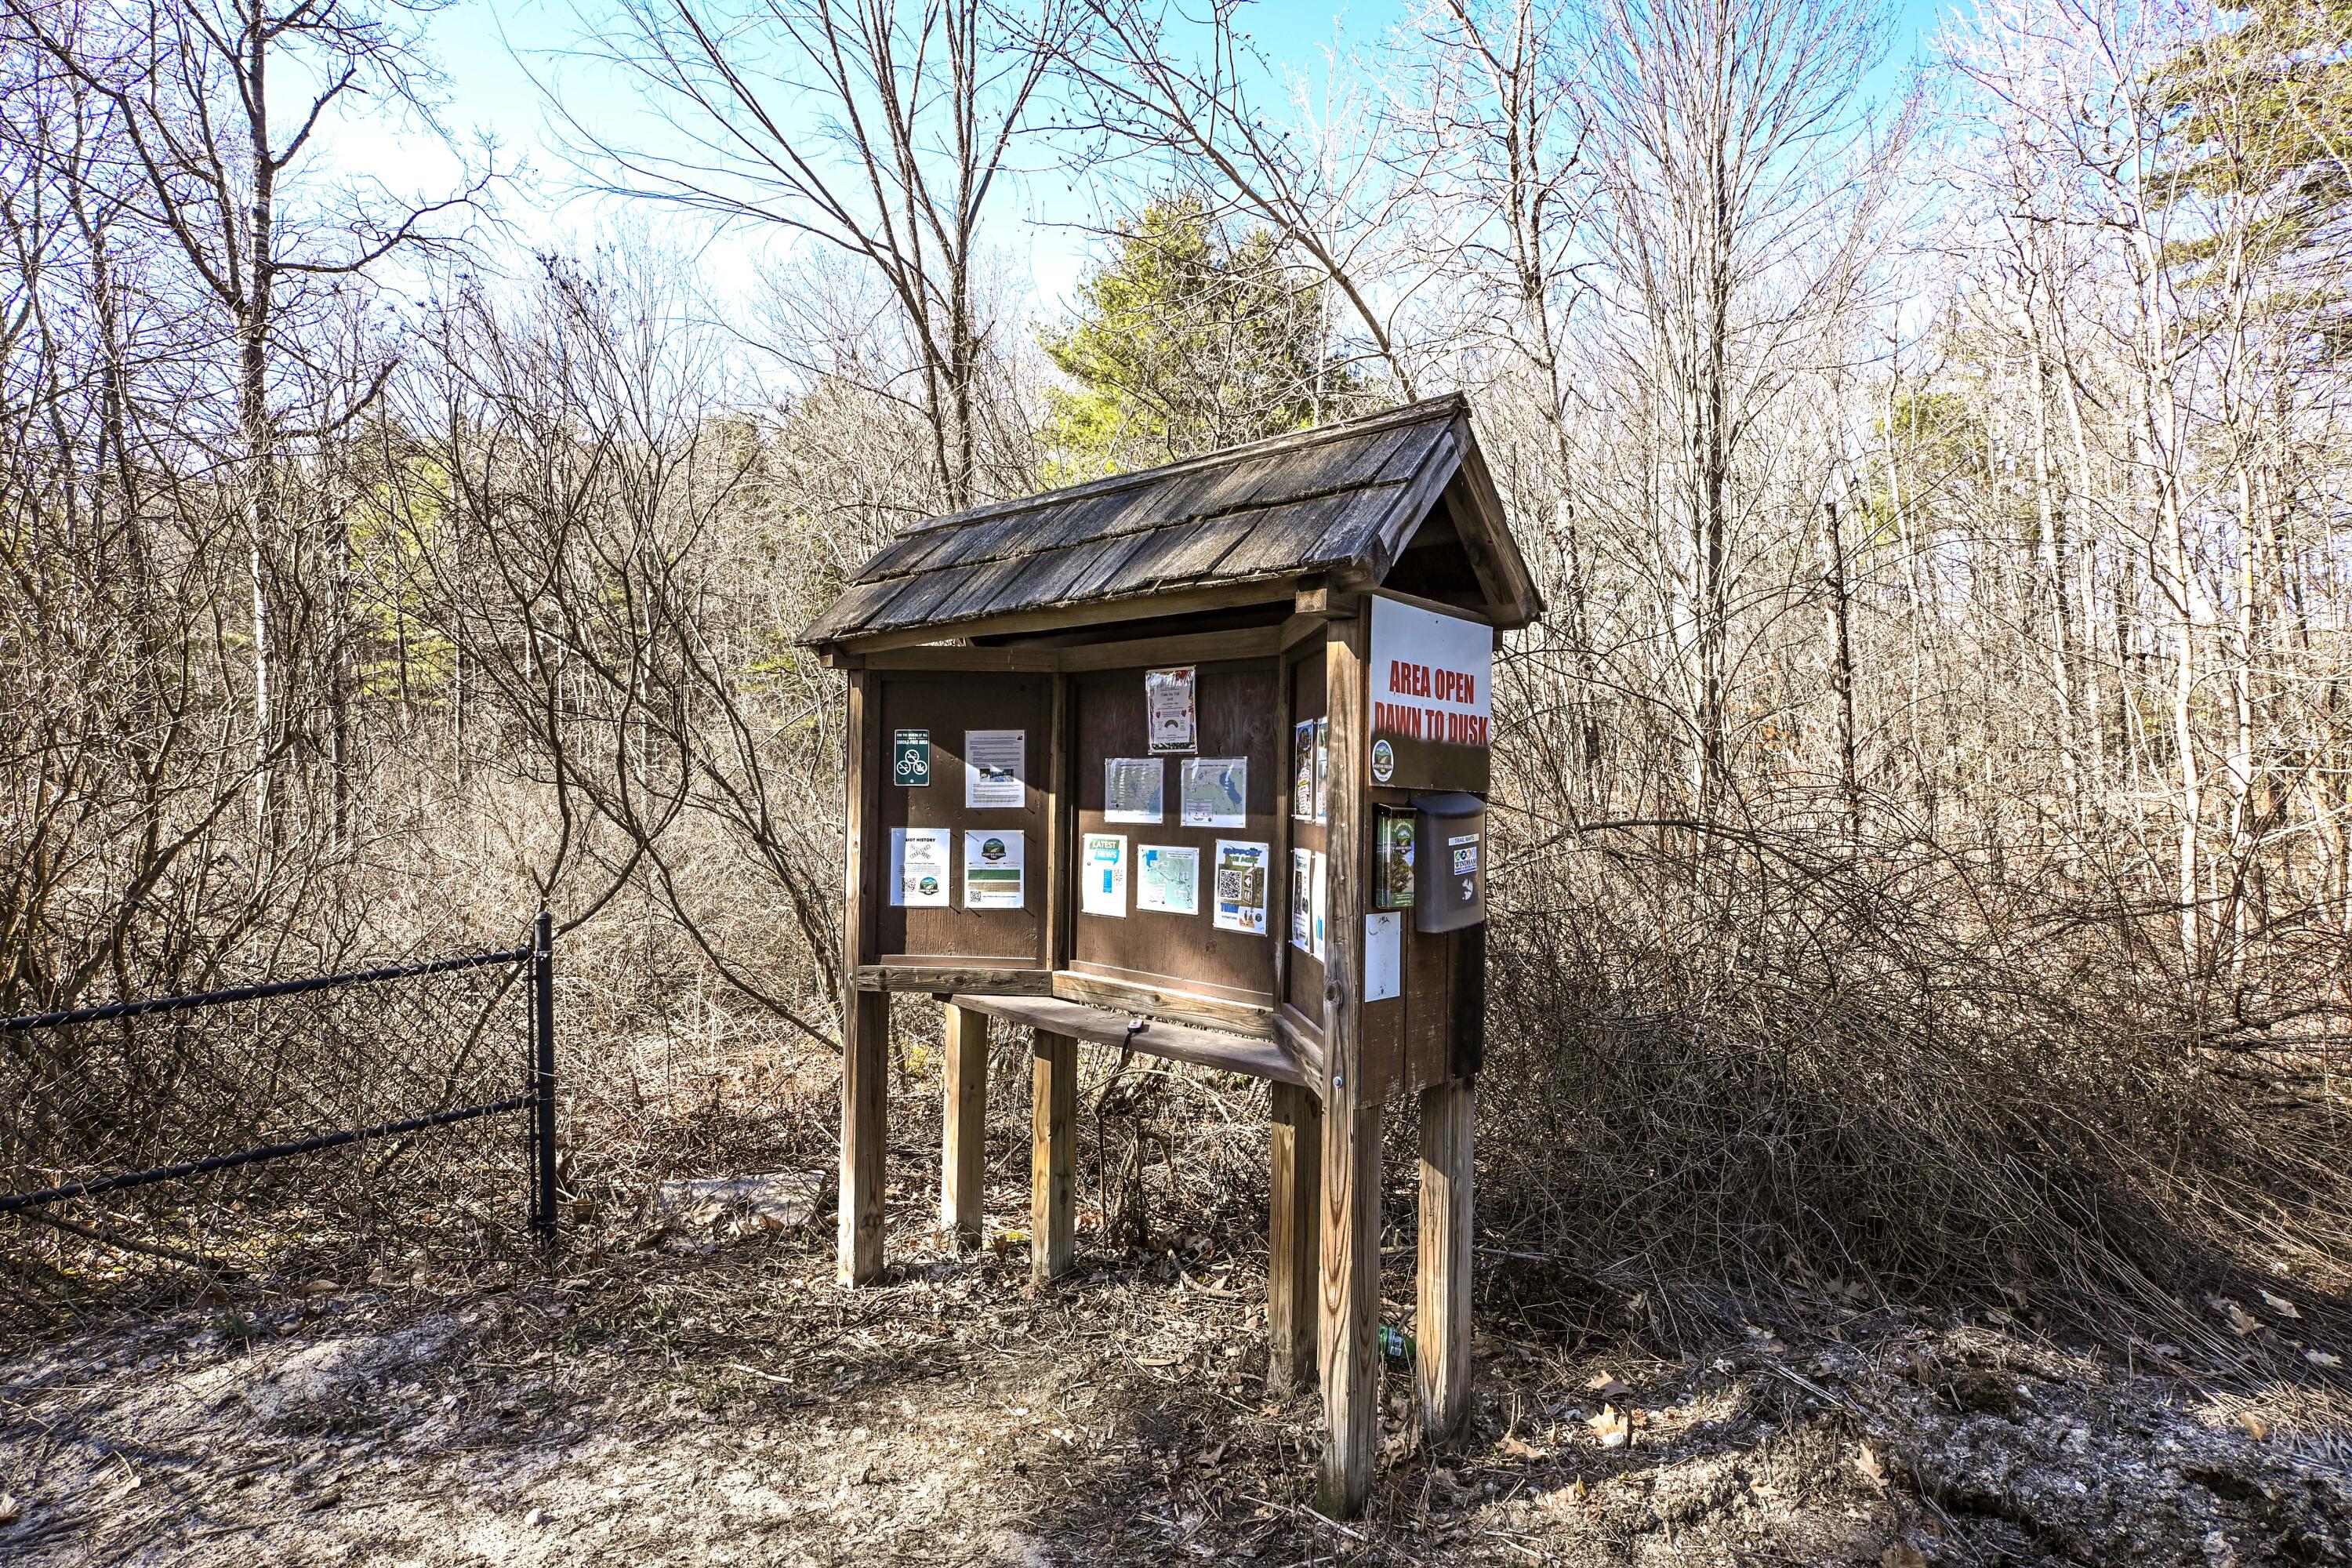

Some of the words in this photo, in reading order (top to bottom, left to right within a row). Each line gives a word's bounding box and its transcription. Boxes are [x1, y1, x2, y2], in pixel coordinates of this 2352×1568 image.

[1389, 660, 1431, 698] AREA
[1435, 668, 1474, 704] OPEN
[1374, 702, 1421, 739] DAWN
[1425, 709, 1444, 741] TO
[1448, 712, 1488, 746] DUSK
[1455, 858, 1476, 867] WINDHAM
